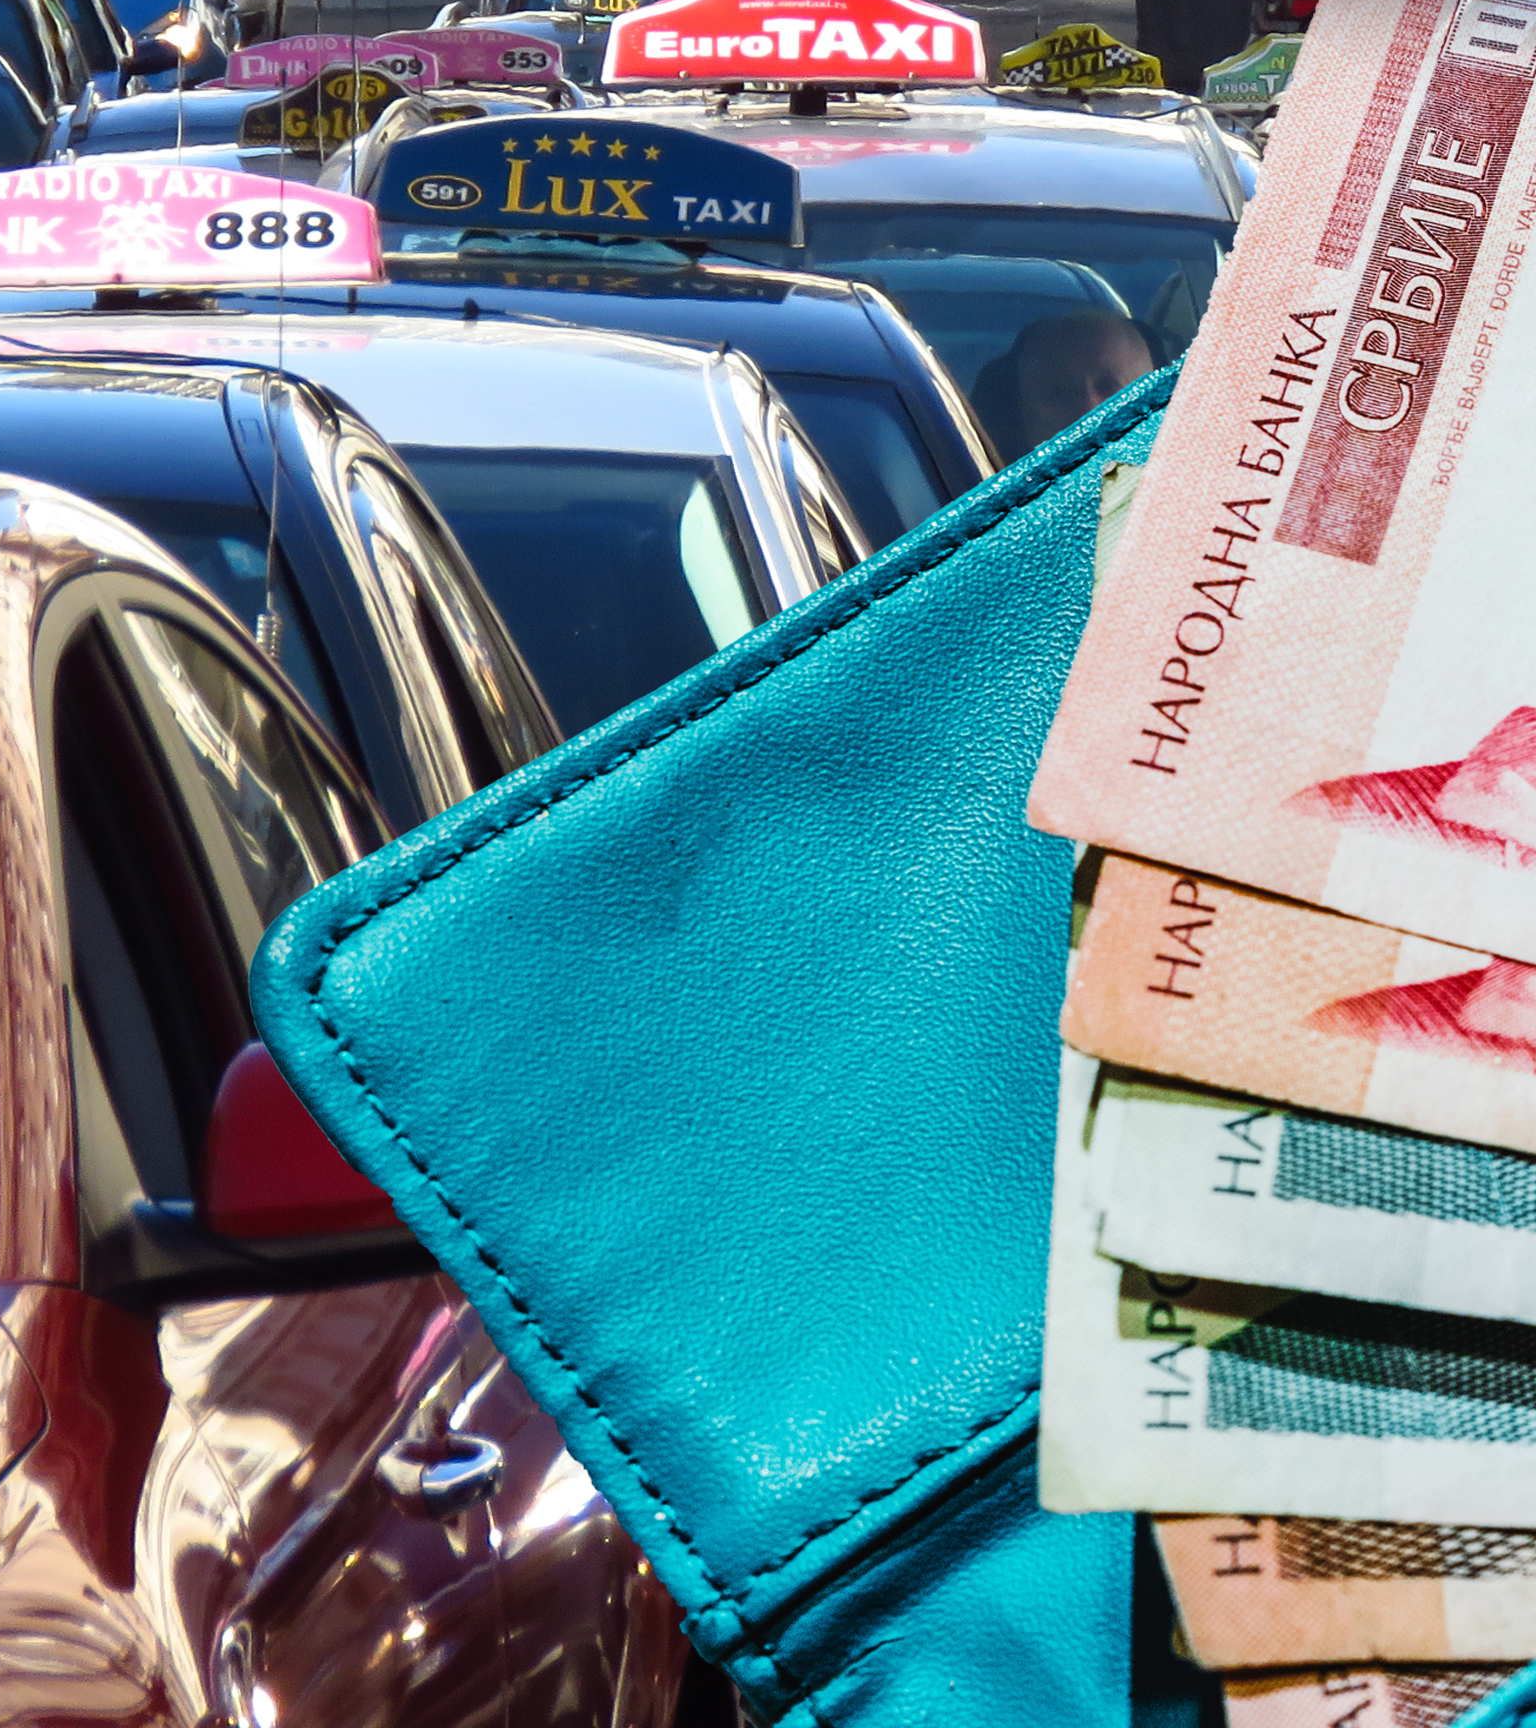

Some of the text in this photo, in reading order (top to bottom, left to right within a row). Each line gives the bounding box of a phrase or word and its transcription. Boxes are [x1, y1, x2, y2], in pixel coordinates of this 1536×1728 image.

[279, 38, 339, 51] RADIO
[643, 17, 955, 63] EuroTAXI
[1047, 27, 1101, 54] TAXI
[502, 51, 549, 69] 553
[140, 168, 233, 200] TAXI
[416, 181, 472, 206] 591
[498, 156, 772, 226] Lux TAXI
[203, 210, 337, 251] 888
[1335, 126, 1500, 436] СРБИЈЕ
[1128, 303, 1339, 776] НАРОДНА БАНКА
